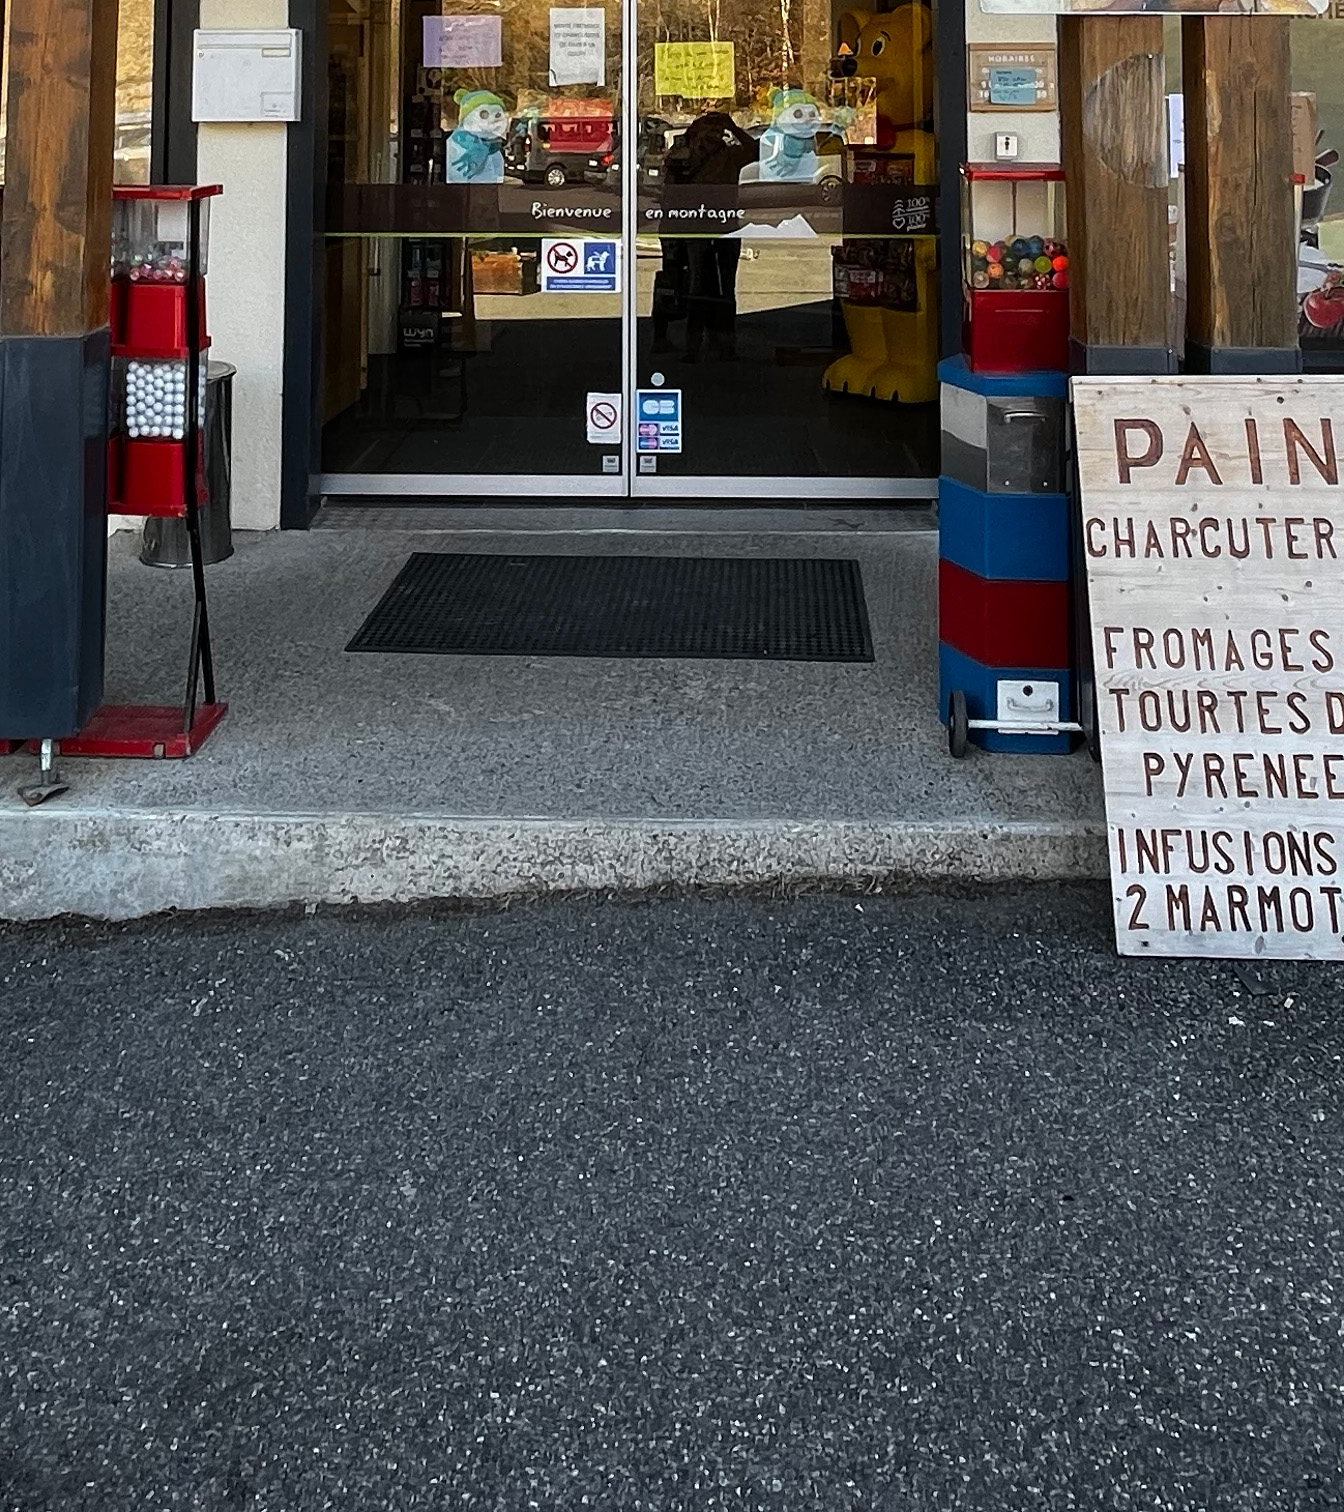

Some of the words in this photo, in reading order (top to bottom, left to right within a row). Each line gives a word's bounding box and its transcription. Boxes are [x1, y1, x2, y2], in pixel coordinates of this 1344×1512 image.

[532, 201, 613, 220] Bienvenue
[645, 208, 664, 220] en
[667, 204, 746, 224] montagne
[1113, 417, 1340, 487] PAIN
[1103, 626, 1334, 674] FROMAGES
[1108, 688, 1312, 736] TOURTES
[1117, 827, 1338, 877] INFUSIONS
[1127, 884, 1151, 931] 2
